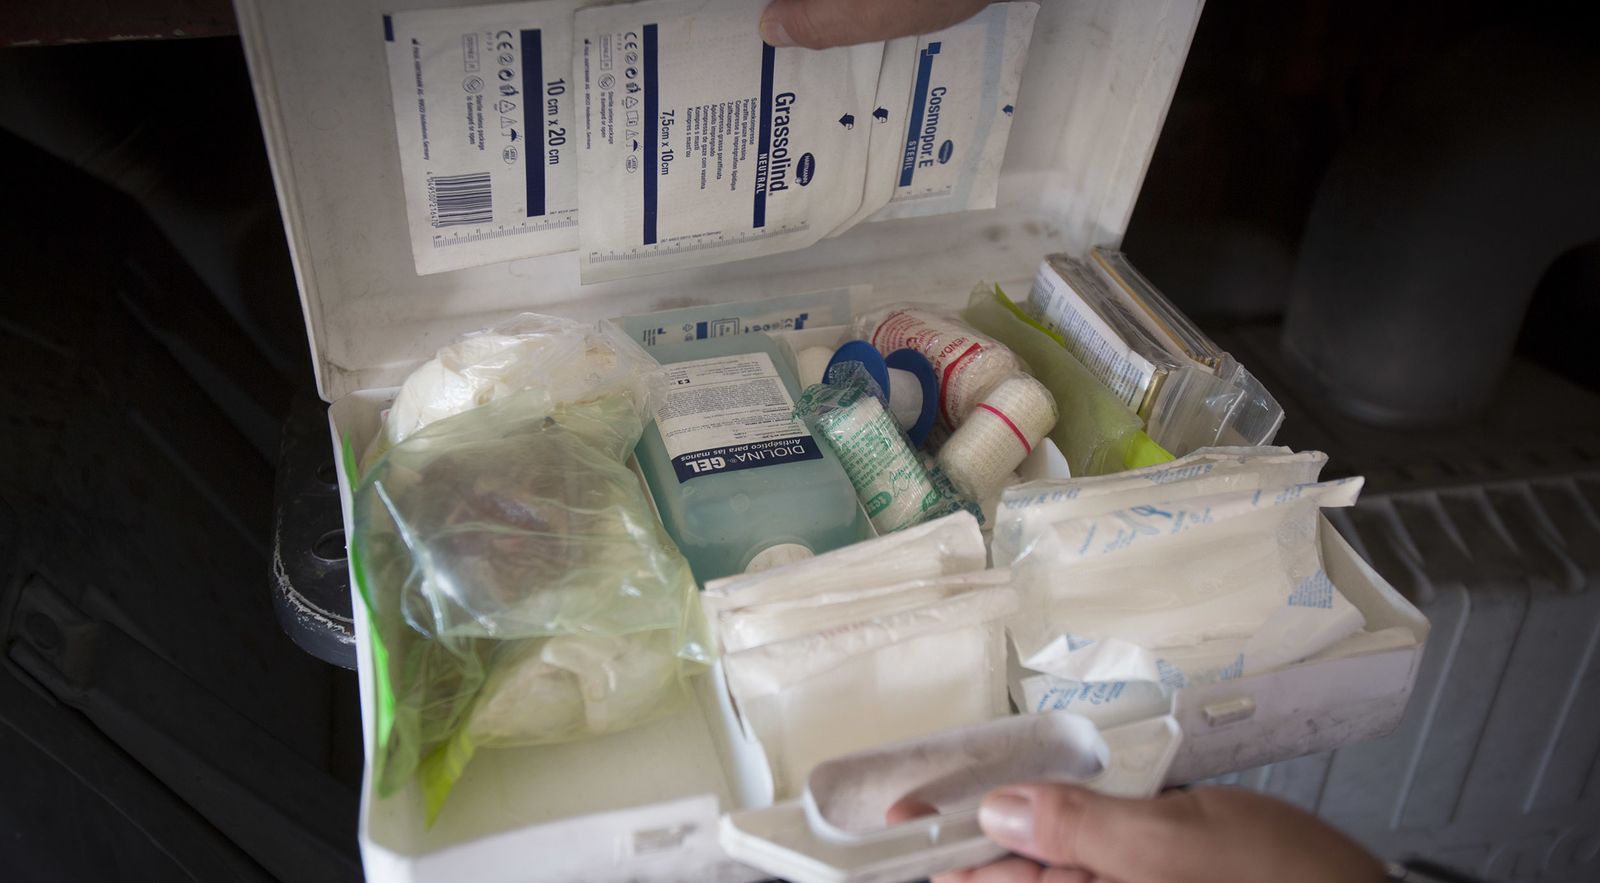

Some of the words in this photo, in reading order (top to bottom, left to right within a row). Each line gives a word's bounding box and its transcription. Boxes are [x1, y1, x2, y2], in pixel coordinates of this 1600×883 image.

[547, 78, 566, 96] 10
[547, 99, 558, 115] cm
[733, 100, 741, 130] Compresse
[749, 97, 757, 145] Salbenkompresse
[548, 129, 566, 146] 20
[548, 149, 559, 165] cm
[740, 139, 748, 161] dressing
[904, 140, 917, 171] STERIL
[919, 159, 933, 169] E
[756, 153, 768, 195] NEUTRAL
[713, 448, 726, 456] las
[728, 444, 748, 453] para
[751, 438, 801, 449] Antiséptico
[680, 451, 710, 461] manos
[685, 456, 726, 473] GEL
